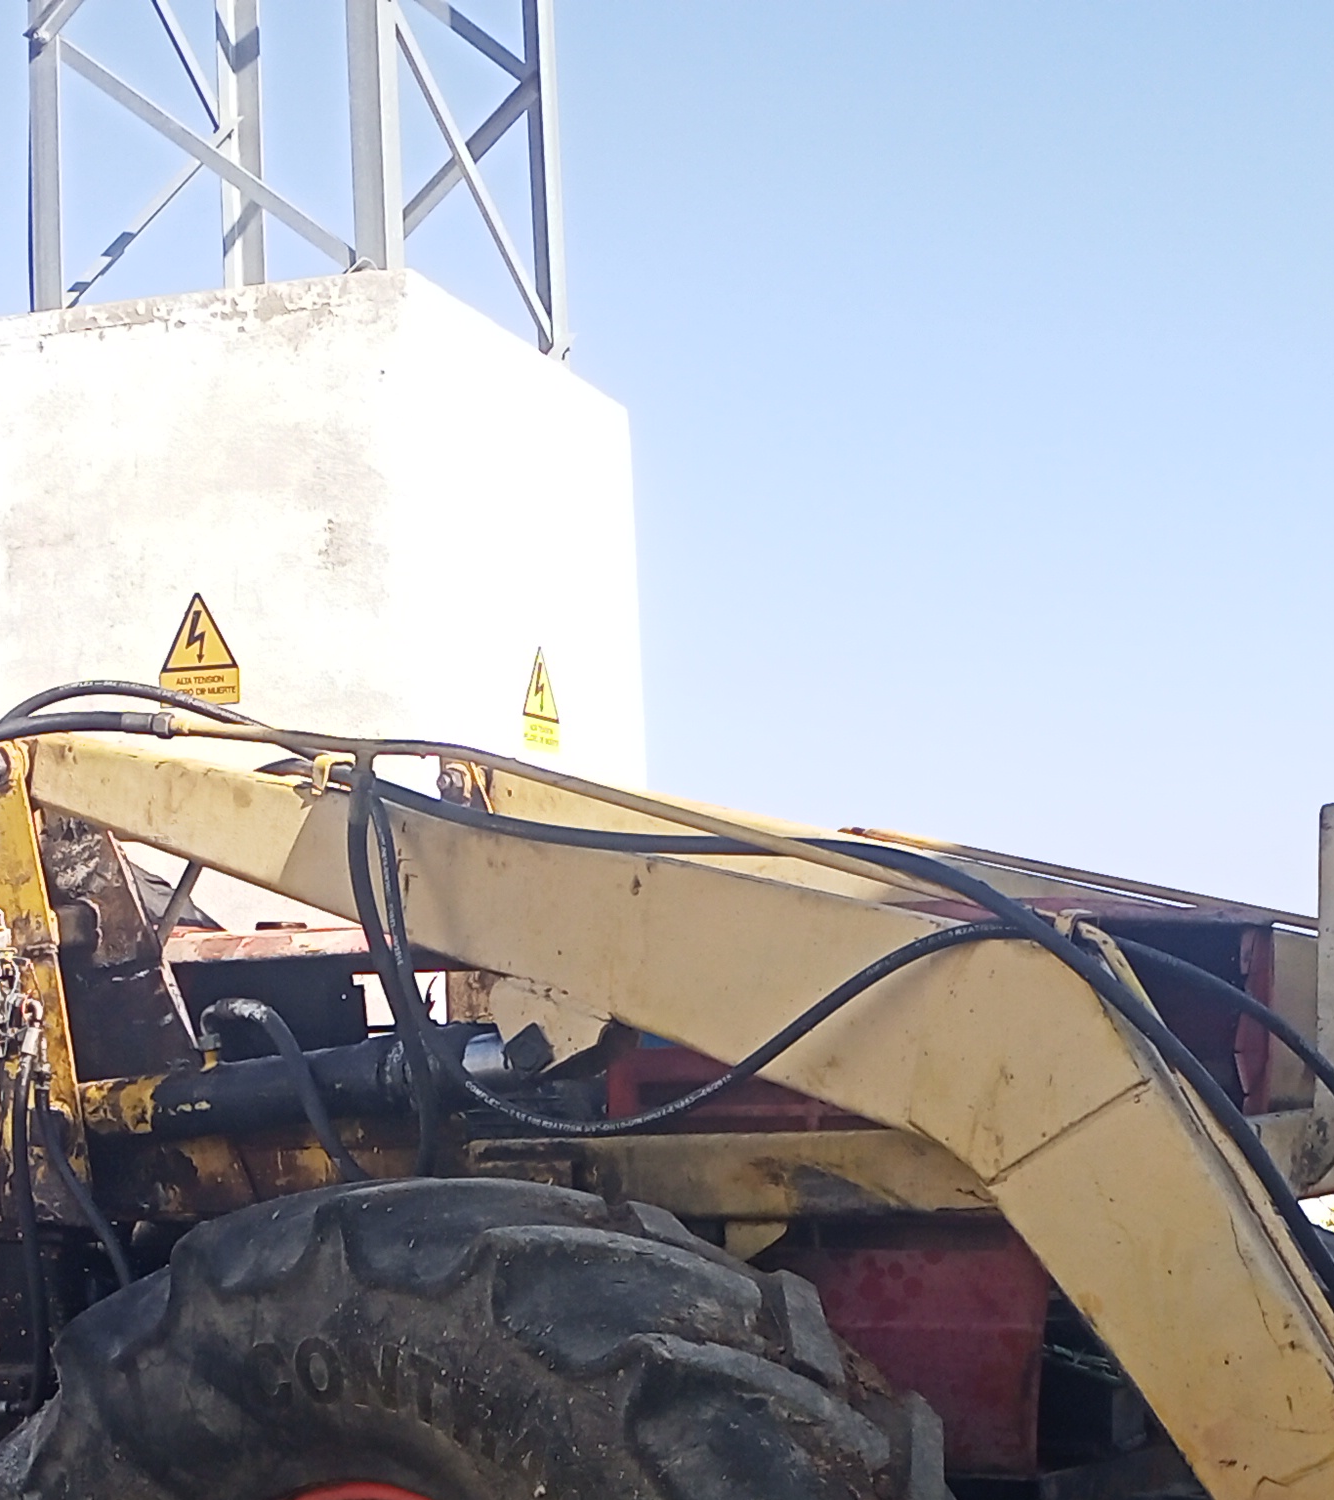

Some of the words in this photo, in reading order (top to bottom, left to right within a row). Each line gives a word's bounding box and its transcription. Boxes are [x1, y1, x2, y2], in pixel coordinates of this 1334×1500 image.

[176, 677, 192, 685] ALTA
[194, 675, 224, 684] TENSION
[208, 686, 235, 694] MUERTE
